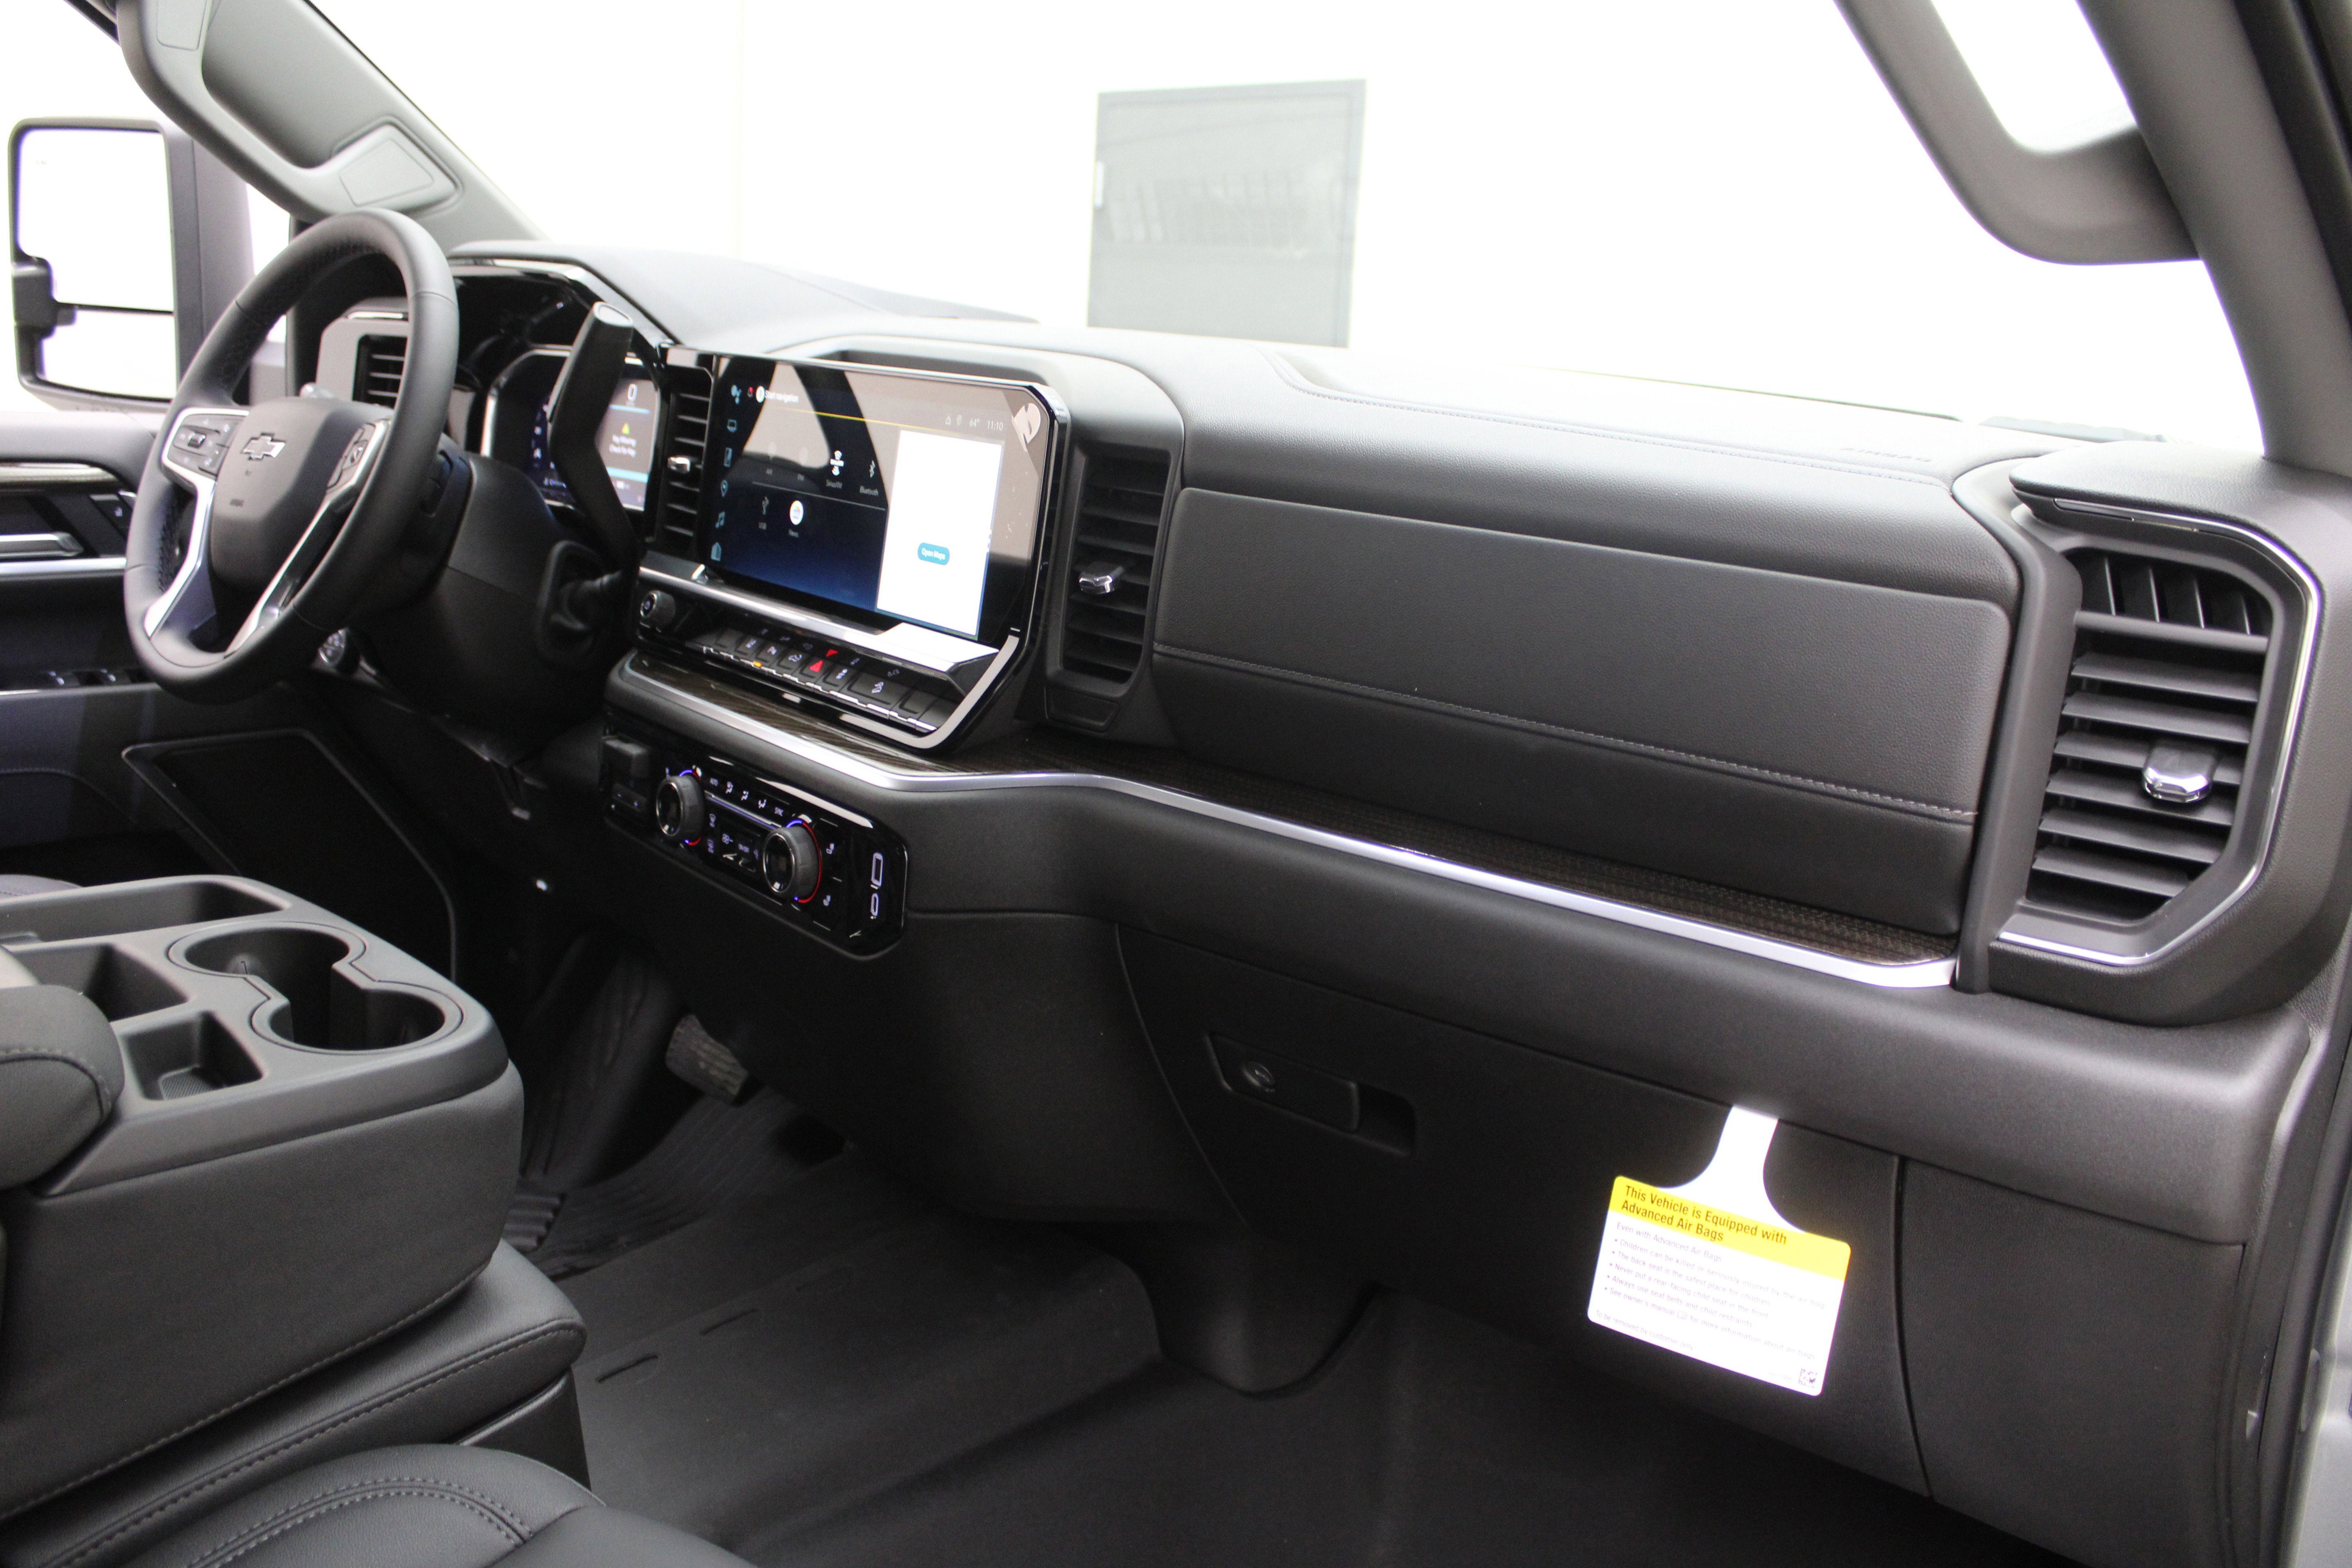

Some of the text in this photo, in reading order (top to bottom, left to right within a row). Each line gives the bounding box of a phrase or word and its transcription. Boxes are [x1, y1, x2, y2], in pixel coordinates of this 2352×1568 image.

[987, 421, 1003, 431] 11:10
[921, 547, 946, 561] Open Maps
[1621, 1199, 1724, 1242] Advanced Air Bags
[1626, 1185, 1787, 1245] This Vehicle is Equipped with
[1616, 1221, 1722, 1262] Even with Advanced Air Bags
[1615, 1263, 1633, 1275] Never
[1635, 1271, 1646, 1280] put
[1693, 1291, 1710, 1301] child
[1712, 1297, 1727, 1306] seat
[1751, 1308, 1768, 1318] front
[1618, 1250, 1629, 1261] The
[1630, 1255, 1646, 1266] back
[1648, 1263, 1663, 1272] seat
[1672, 1270, 1683, 1279] the
[1685, 1275, 1706, 1286] safest
[1707, 1282, 1727, 1292] place
[1741, 1293, 1770, 1304] children
[1619, 1238, 1648, 1254] Children
[1650, 1250, 1663, 1258] can
[1664, 1254, 1673, 1262] be
[1675, 1258, 1695, 1270] killed
[1707, 1269, 1740, 1284] seriously
[1742, 1281, 1769, 1291] injured
[1771, 1287, 1780, 1296] by
[1811, 1299, 1825, 1310] bag
[1609, 1287, 1622, 1297] See
[1623, 1293, 1649, 1307] owner's
[1650, 1303, 1675, 1316] manual
[1690, 1315, 1699, 1323] for
[1701, 1320, 1719, 1330] more
[1721, 1327, 1761, 1342] information
[1763, 1340, 1784, 1350] about
[1797, 1350, 1815, 1359] bags
[1612, 1275, 1752, 1327] Always use seat belts and child restraints
[1596, 1309, 1693, 1351] To be removed by customer only
